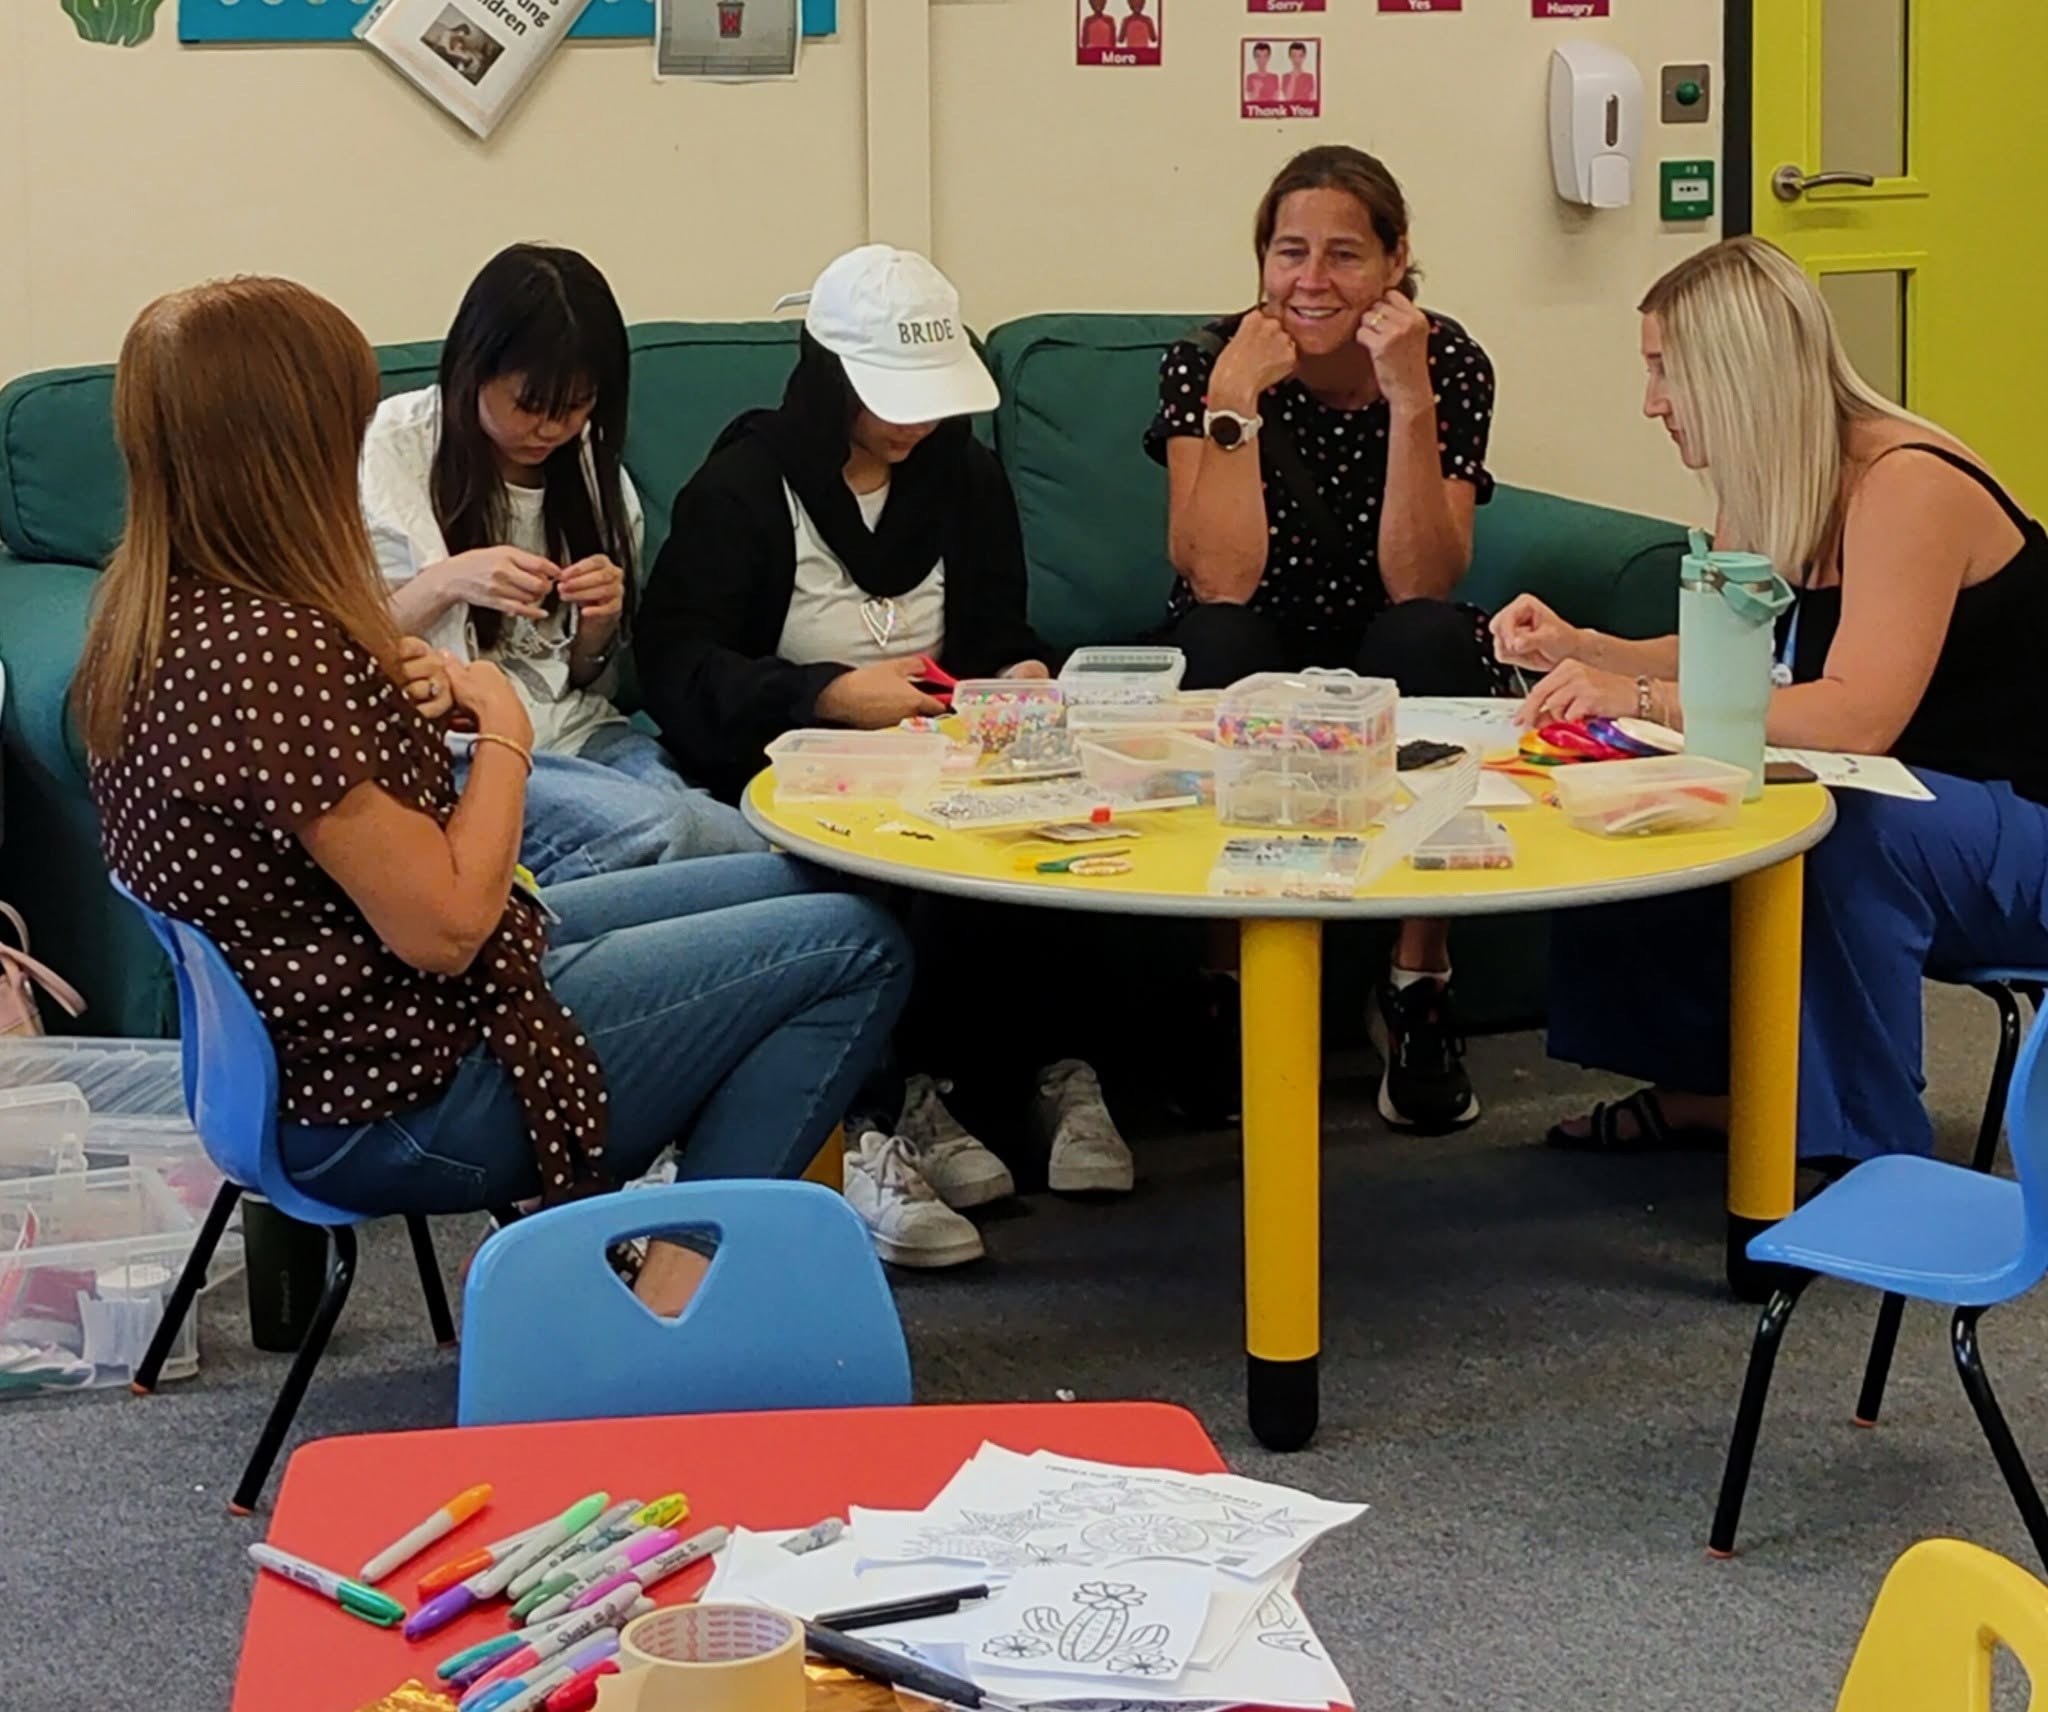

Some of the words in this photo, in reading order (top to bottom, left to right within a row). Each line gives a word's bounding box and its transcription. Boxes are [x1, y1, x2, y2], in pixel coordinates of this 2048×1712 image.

[1547, 2, 1595, 17] Hungry
[1101, 51, 1136, 64] More
[1246, 104, 1287, 117] Thank
[1290, 105, 1314, 117] You
[897, 318, 955, 344] BRIDE
